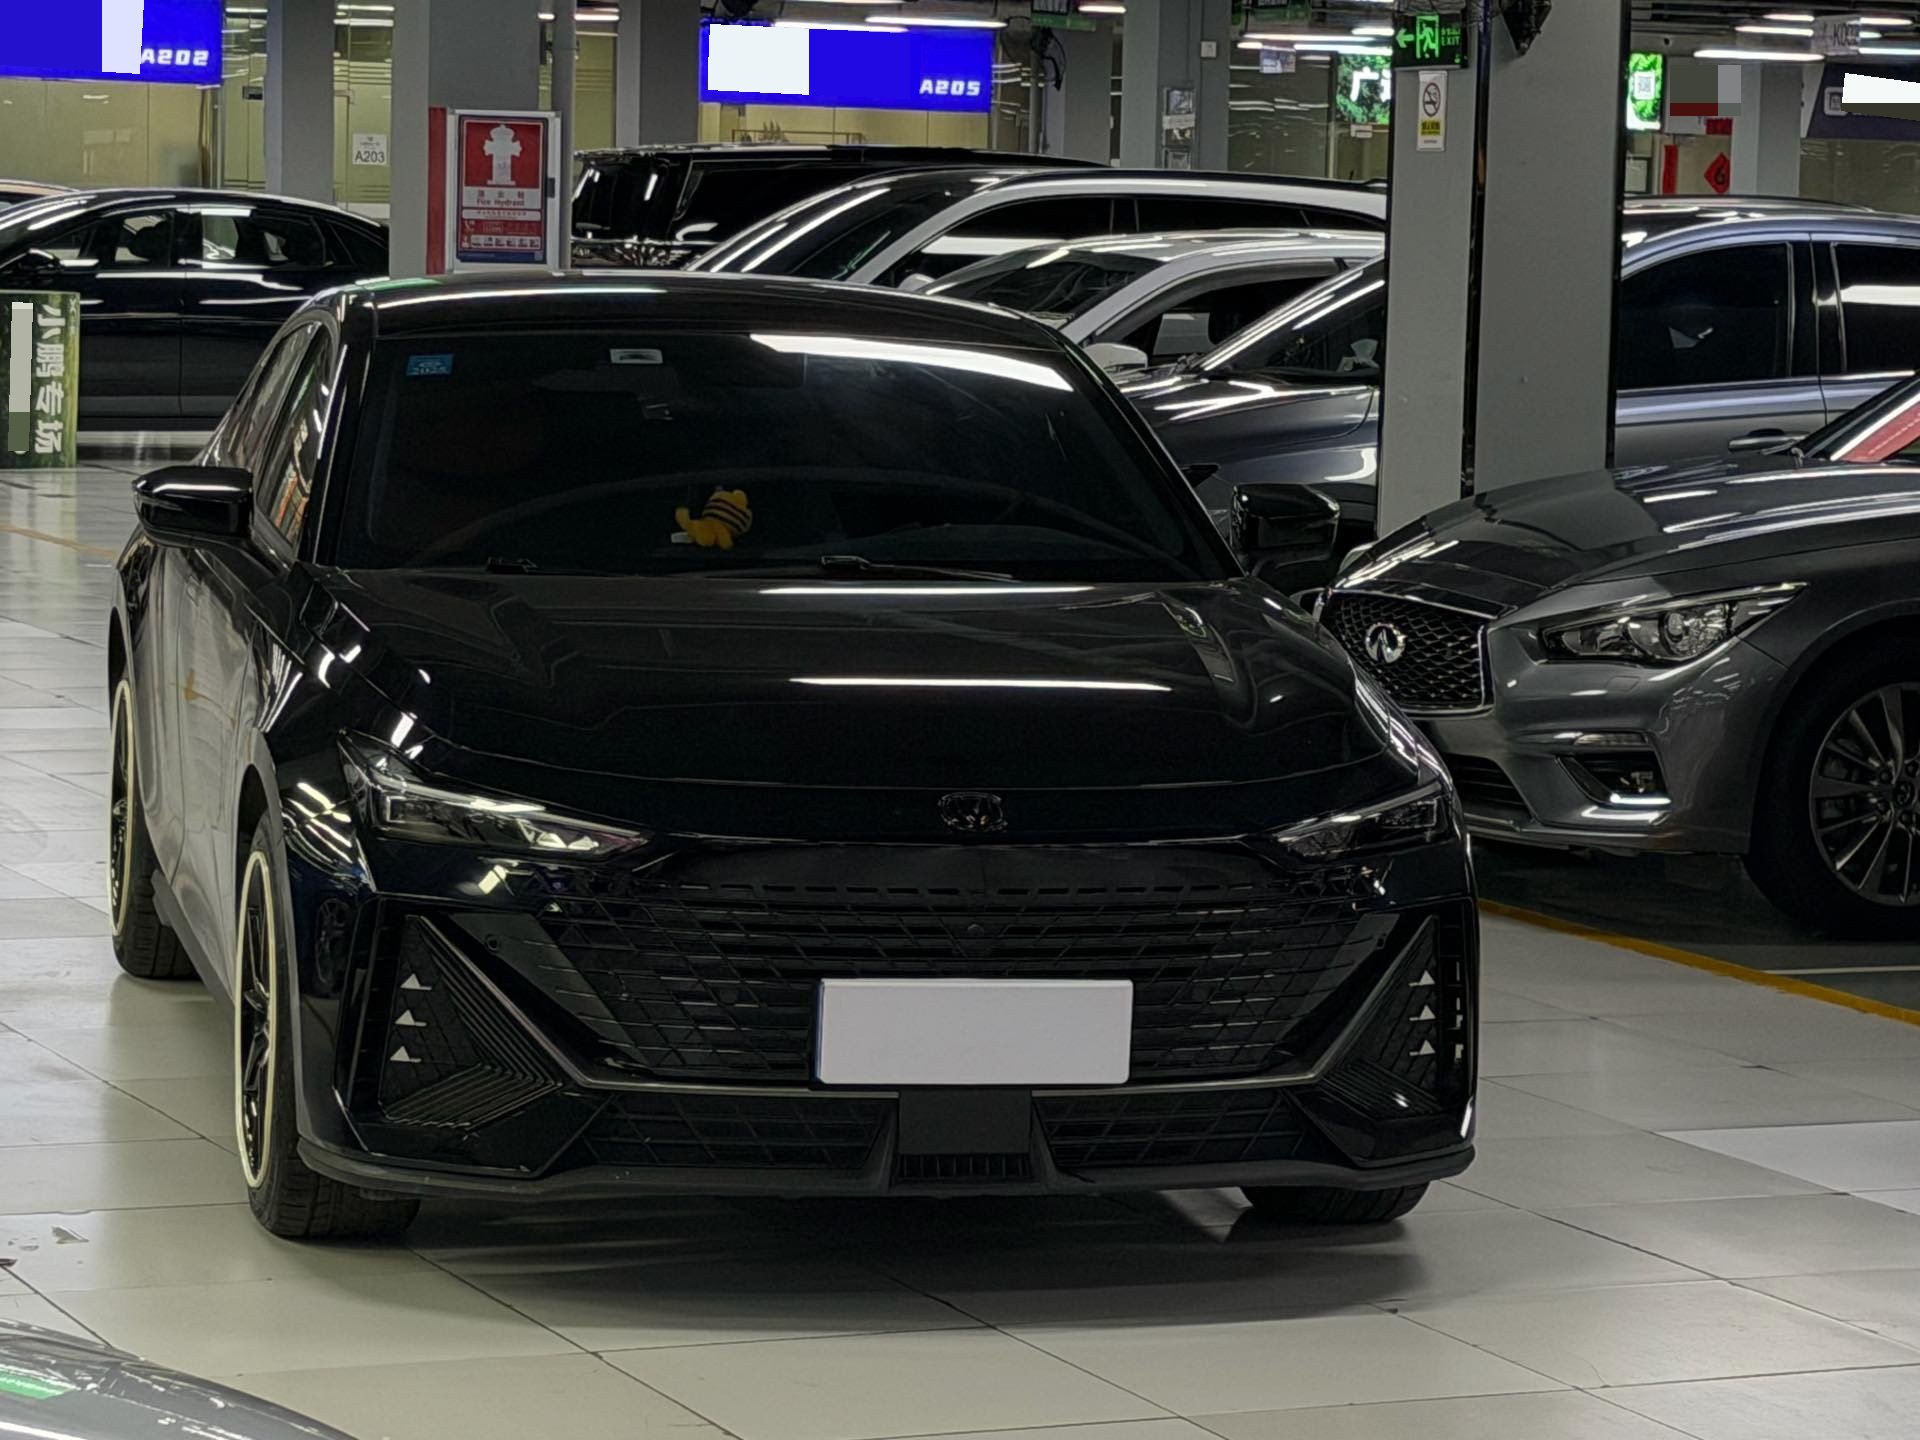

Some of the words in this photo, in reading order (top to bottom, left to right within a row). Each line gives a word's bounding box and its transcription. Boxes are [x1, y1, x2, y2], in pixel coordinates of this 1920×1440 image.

[1441, 36, 1460, 46] EXIT
[141, 48, 209, 66] A202
[919, 79, 981, 96] A205
[354, 150, 385, 163] A203
[35, 303, 65, 454] 小鹏专场
